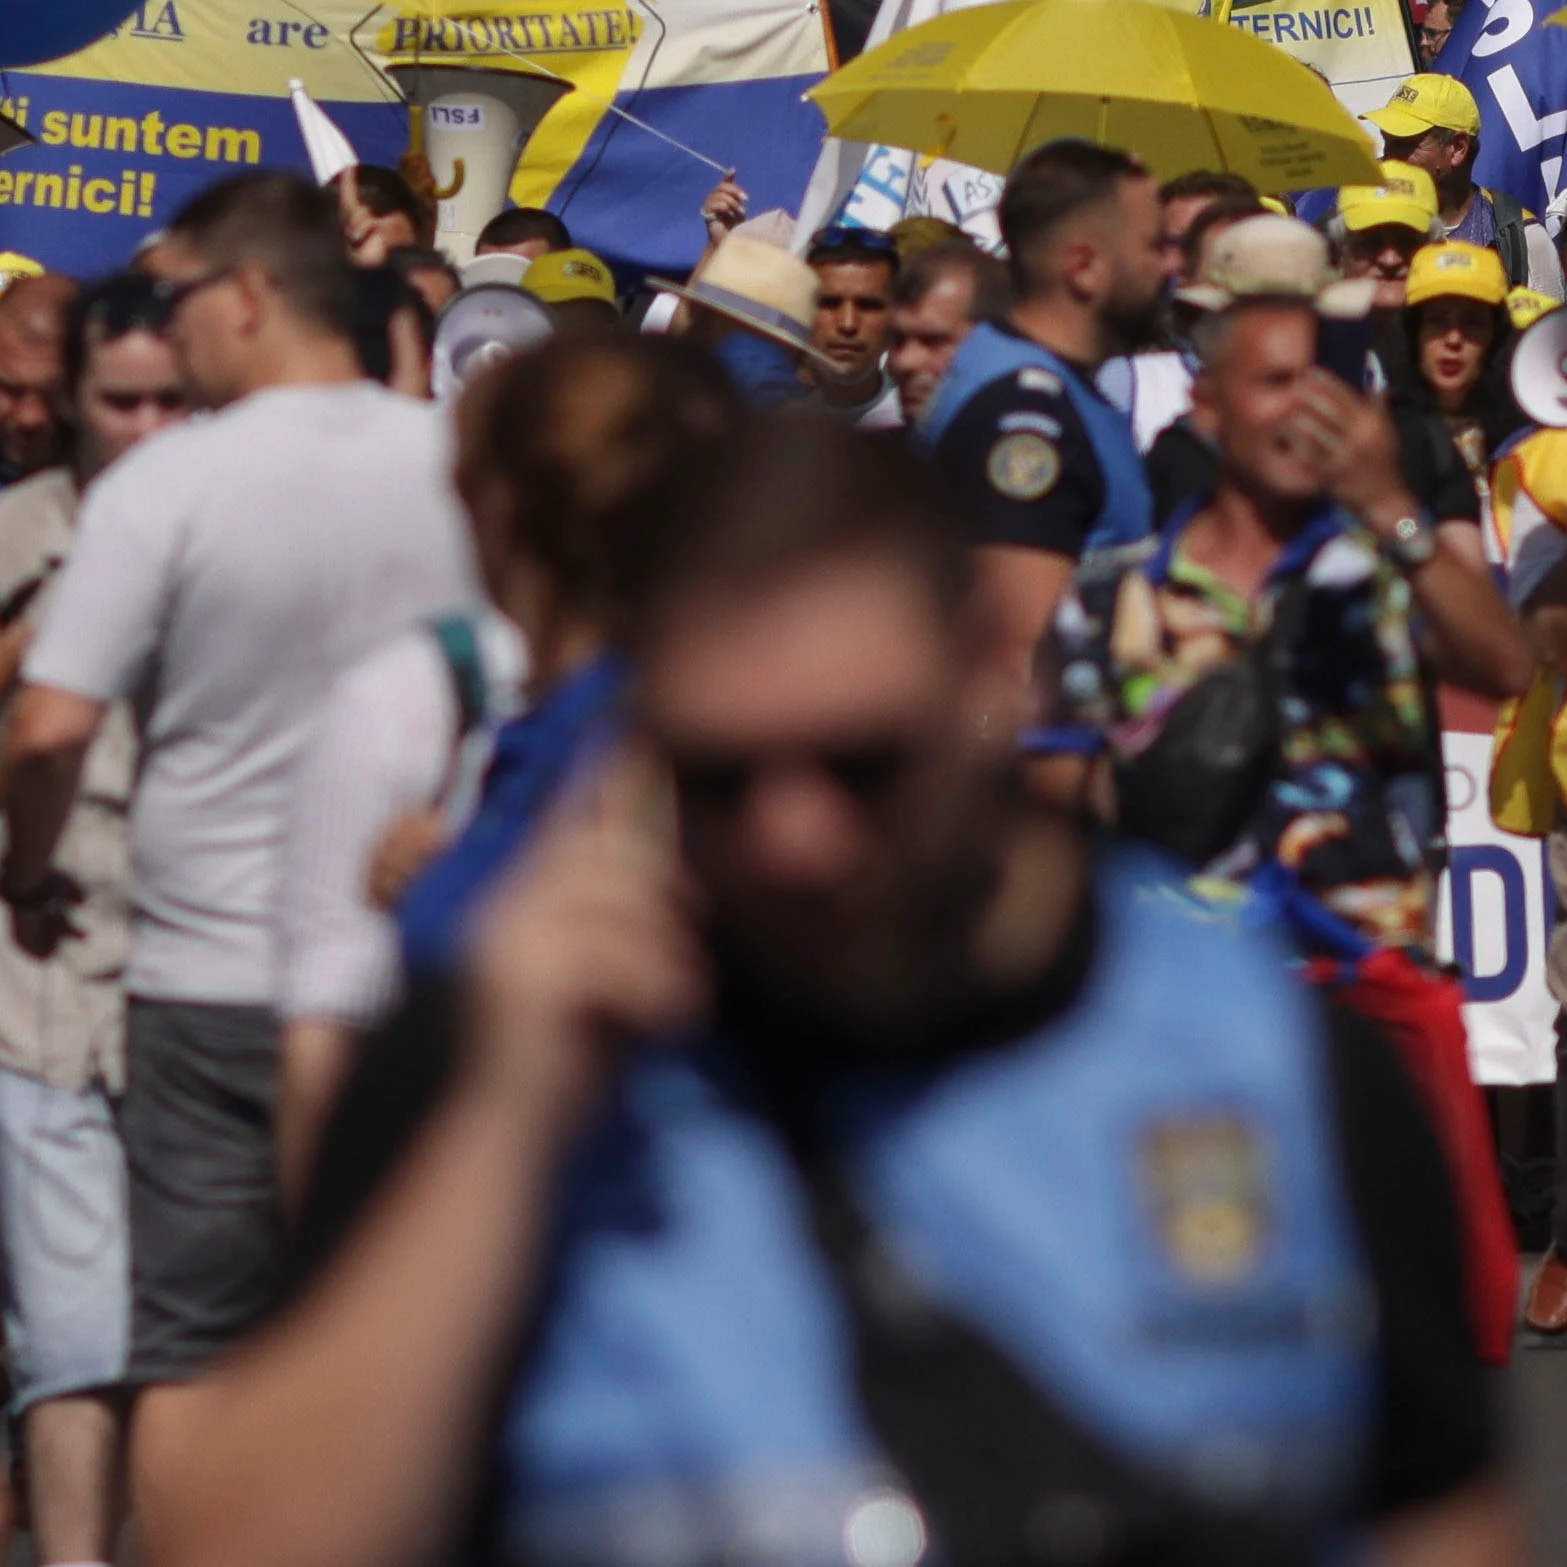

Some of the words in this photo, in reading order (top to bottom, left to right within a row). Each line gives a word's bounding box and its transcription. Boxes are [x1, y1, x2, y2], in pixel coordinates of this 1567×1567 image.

[246, 17, 328, 50] are
[392, 7, 638, 53] PRIORITATE!
[41, 110, 262, 165] suntem
[432, 106, 480, 125] FSLI
